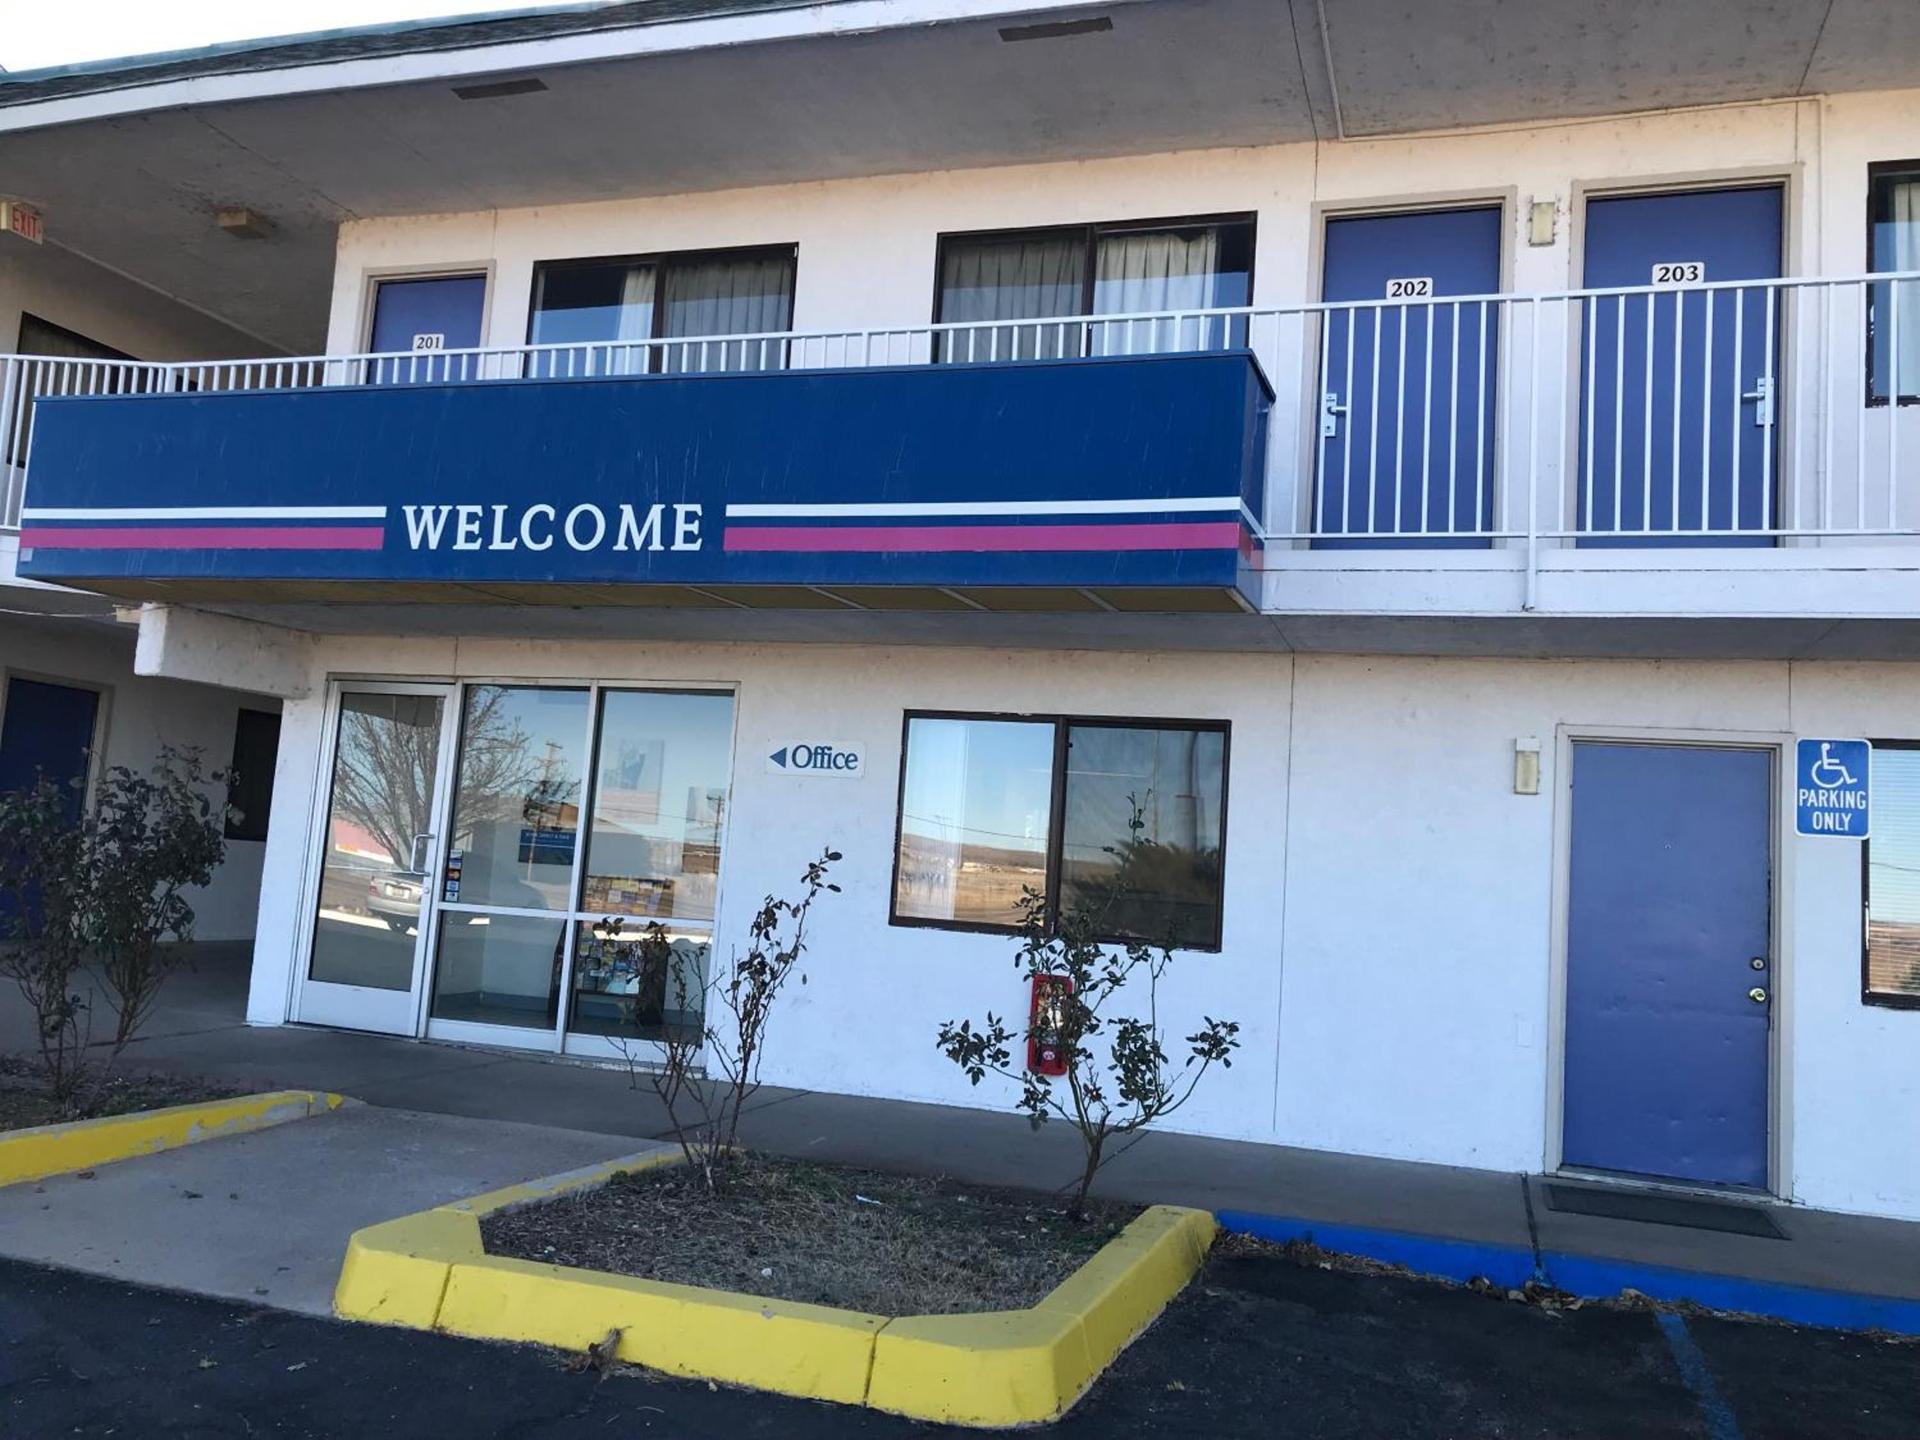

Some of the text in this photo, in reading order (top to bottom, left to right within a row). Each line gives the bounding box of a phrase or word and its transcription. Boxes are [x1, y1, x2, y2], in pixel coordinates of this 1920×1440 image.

[12, 206, 37, 239] EXIT
[1658, 265, 1698, 282] 203
[1391, 281, 1427, 297] 202
[417, 336, 440, 349] 201
[402, 503, 702, 551] WELCOME
[791, 744, 858, 770] Office
[1799, 788, 1867, 810] PARKING
[1812, 811, 1852, 832] ONLY
